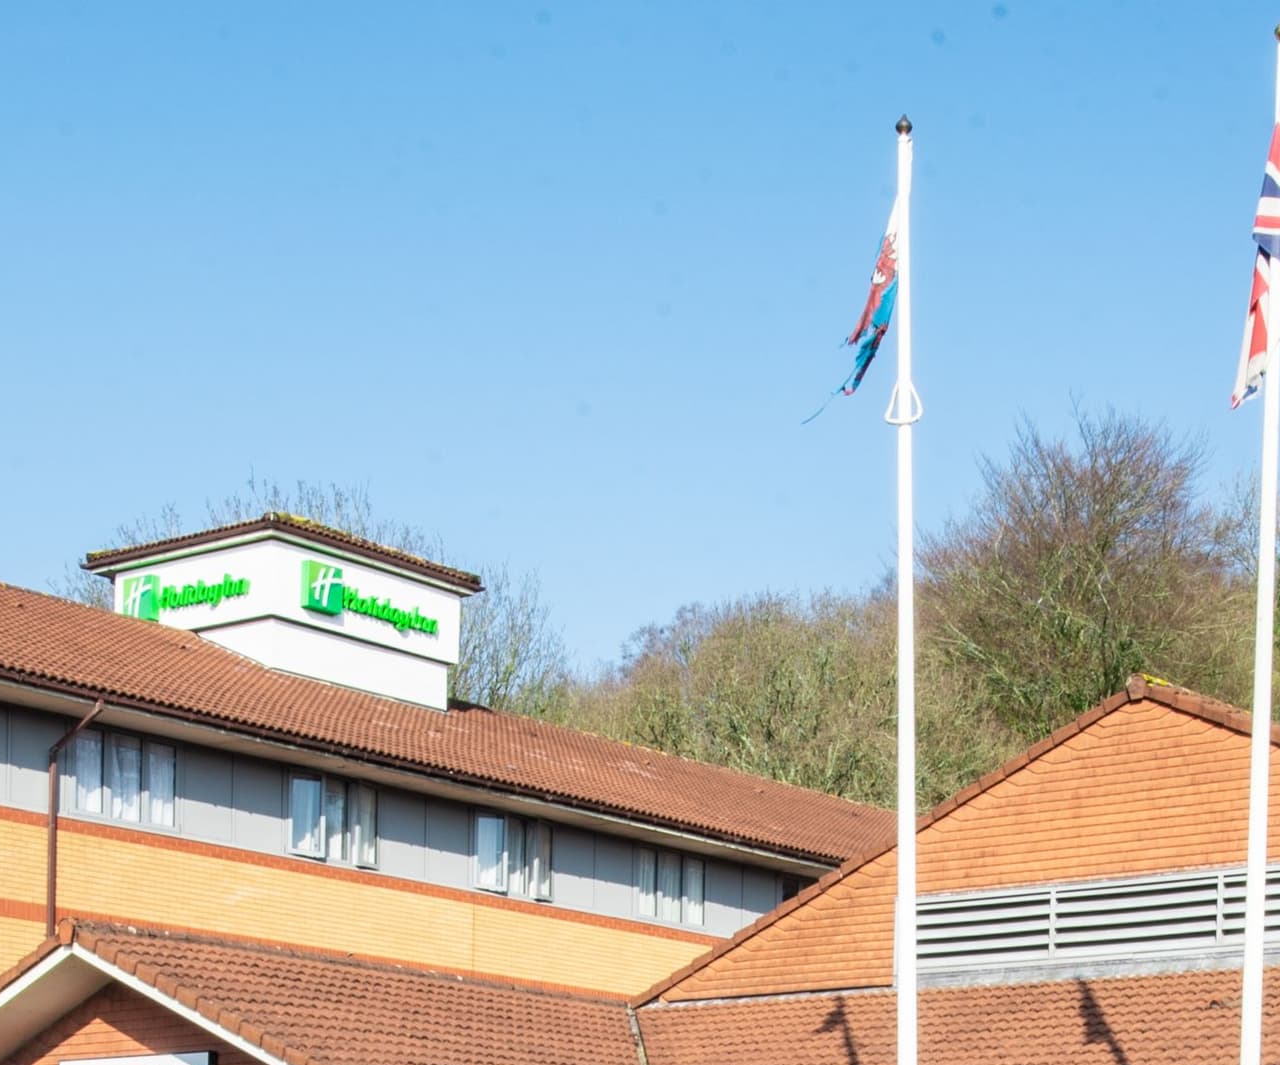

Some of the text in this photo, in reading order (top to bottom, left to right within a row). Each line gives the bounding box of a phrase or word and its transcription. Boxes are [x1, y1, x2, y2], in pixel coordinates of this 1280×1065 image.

[159, 579, 223, 609] Holiday
[223, 573, 250, 598] Inn
[342, 586, 411, 632] Holiday
[410, 606, 438, 634] Inn
